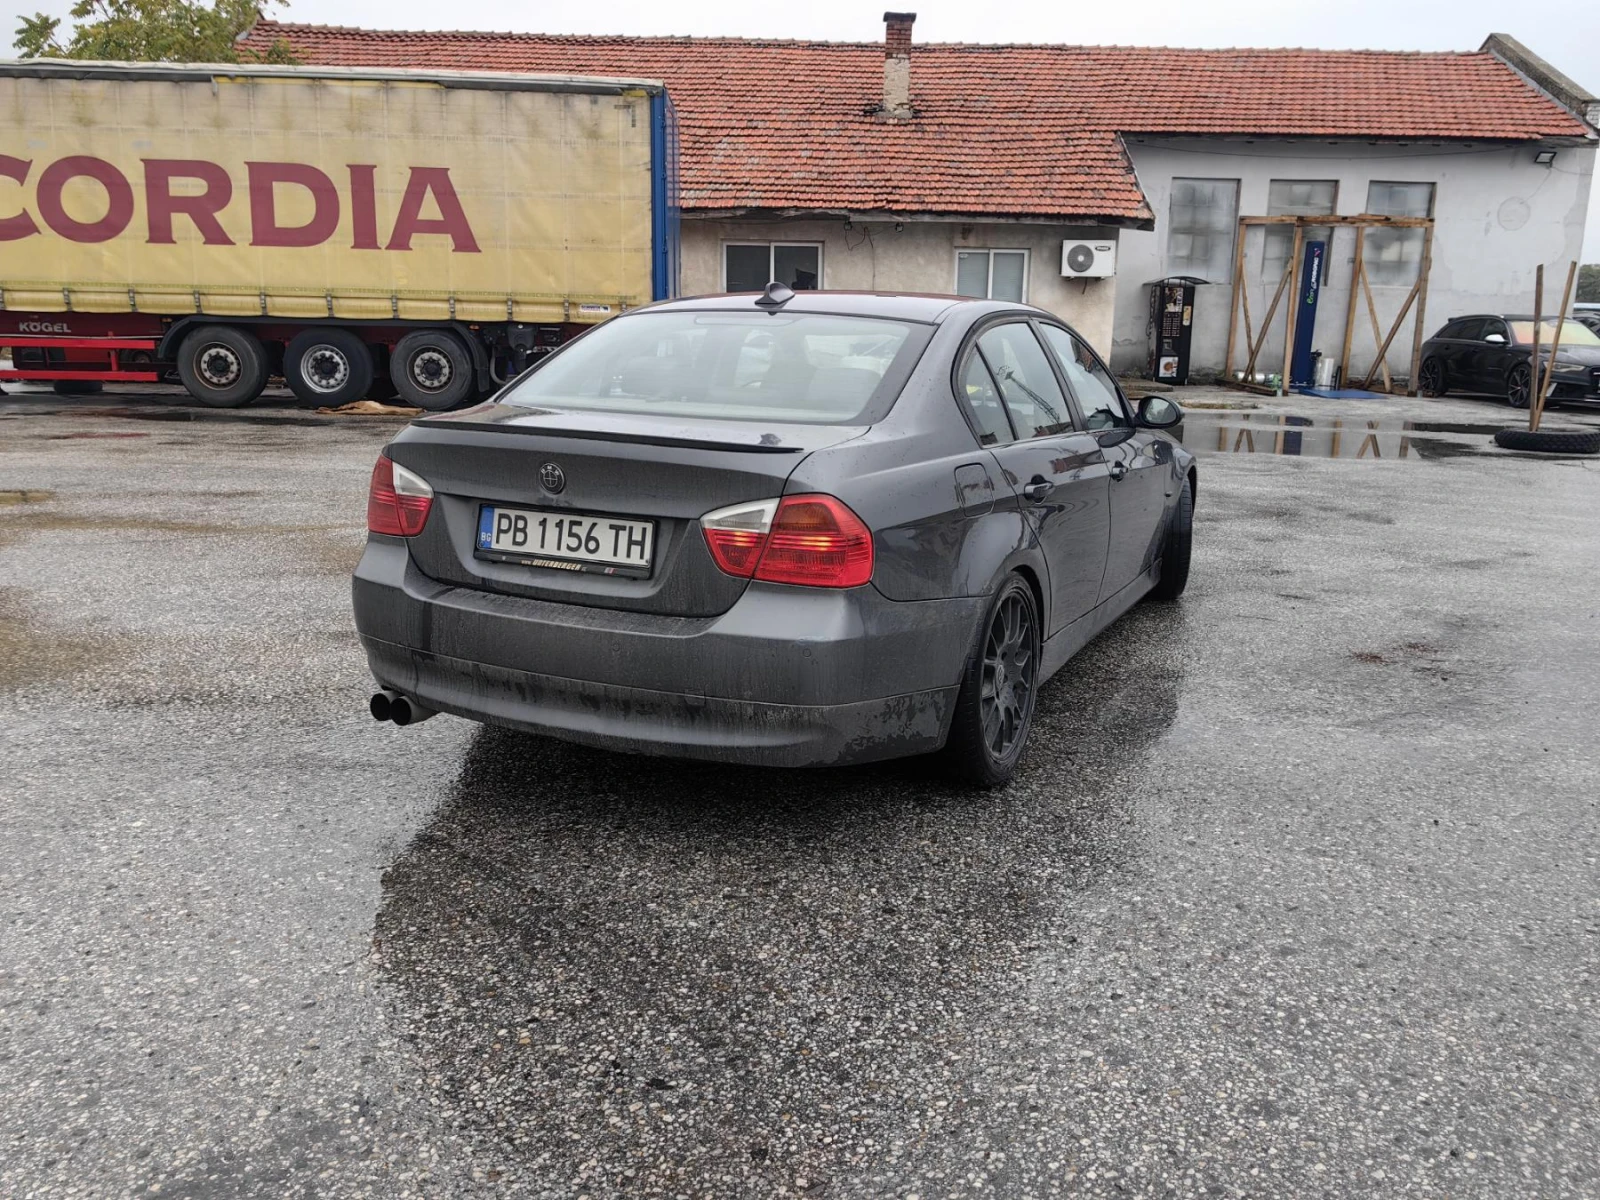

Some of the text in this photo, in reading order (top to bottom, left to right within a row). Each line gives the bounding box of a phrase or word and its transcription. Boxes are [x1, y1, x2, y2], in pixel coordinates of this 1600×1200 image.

[19, 321, 71, 333] KÖGEL
[481, 531, 492, 542] BG
[495, 513, 648, 561] PB 1156 TH
